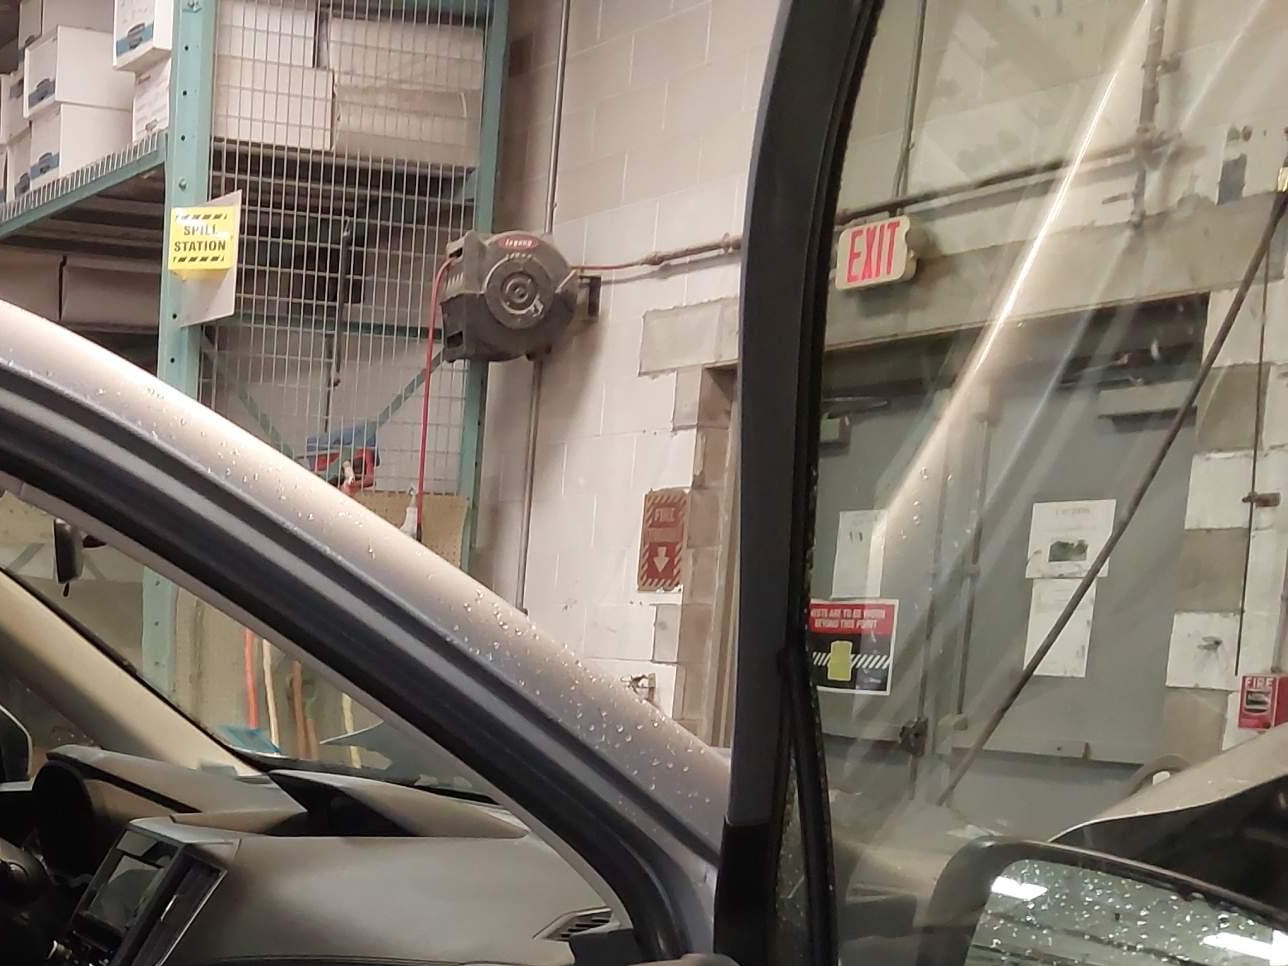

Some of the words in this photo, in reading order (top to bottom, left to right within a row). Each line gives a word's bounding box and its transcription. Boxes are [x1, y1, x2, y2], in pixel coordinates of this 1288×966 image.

[183, 225, 217, 236] SPILL
[173, 240, 227, 252] STATION
[846, 221, 901, 283] EXIT
[1245, 677, 1273, 689] FIRE
